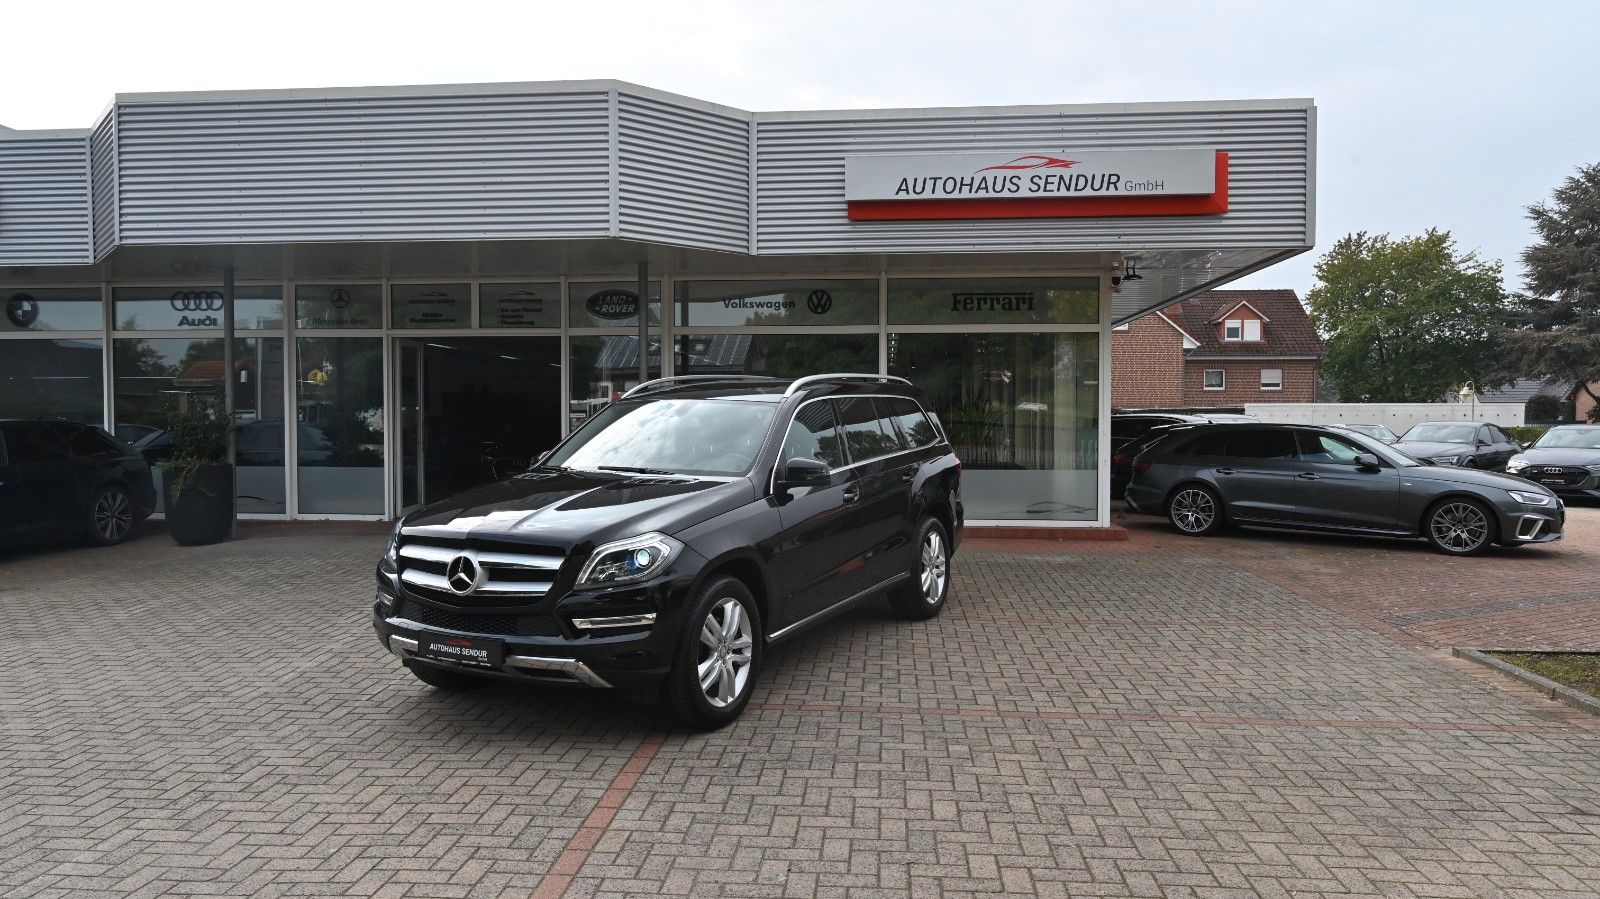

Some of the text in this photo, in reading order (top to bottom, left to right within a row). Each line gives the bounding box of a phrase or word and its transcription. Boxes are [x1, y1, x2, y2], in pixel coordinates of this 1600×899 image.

[895, 173, 1164, 196] AUTOHAUS SENDUR GmbH
[598, 295, 626, 304] LAND
[723, 298, 796, 310] Volkswagen
[950, 293, 1034, 312] Ferrari
[601, 304, 635, 313] ROVER
[178, 315, 218, 327] Audi
[430, 643, 488, 658] AUTOHAUS SENDUR
